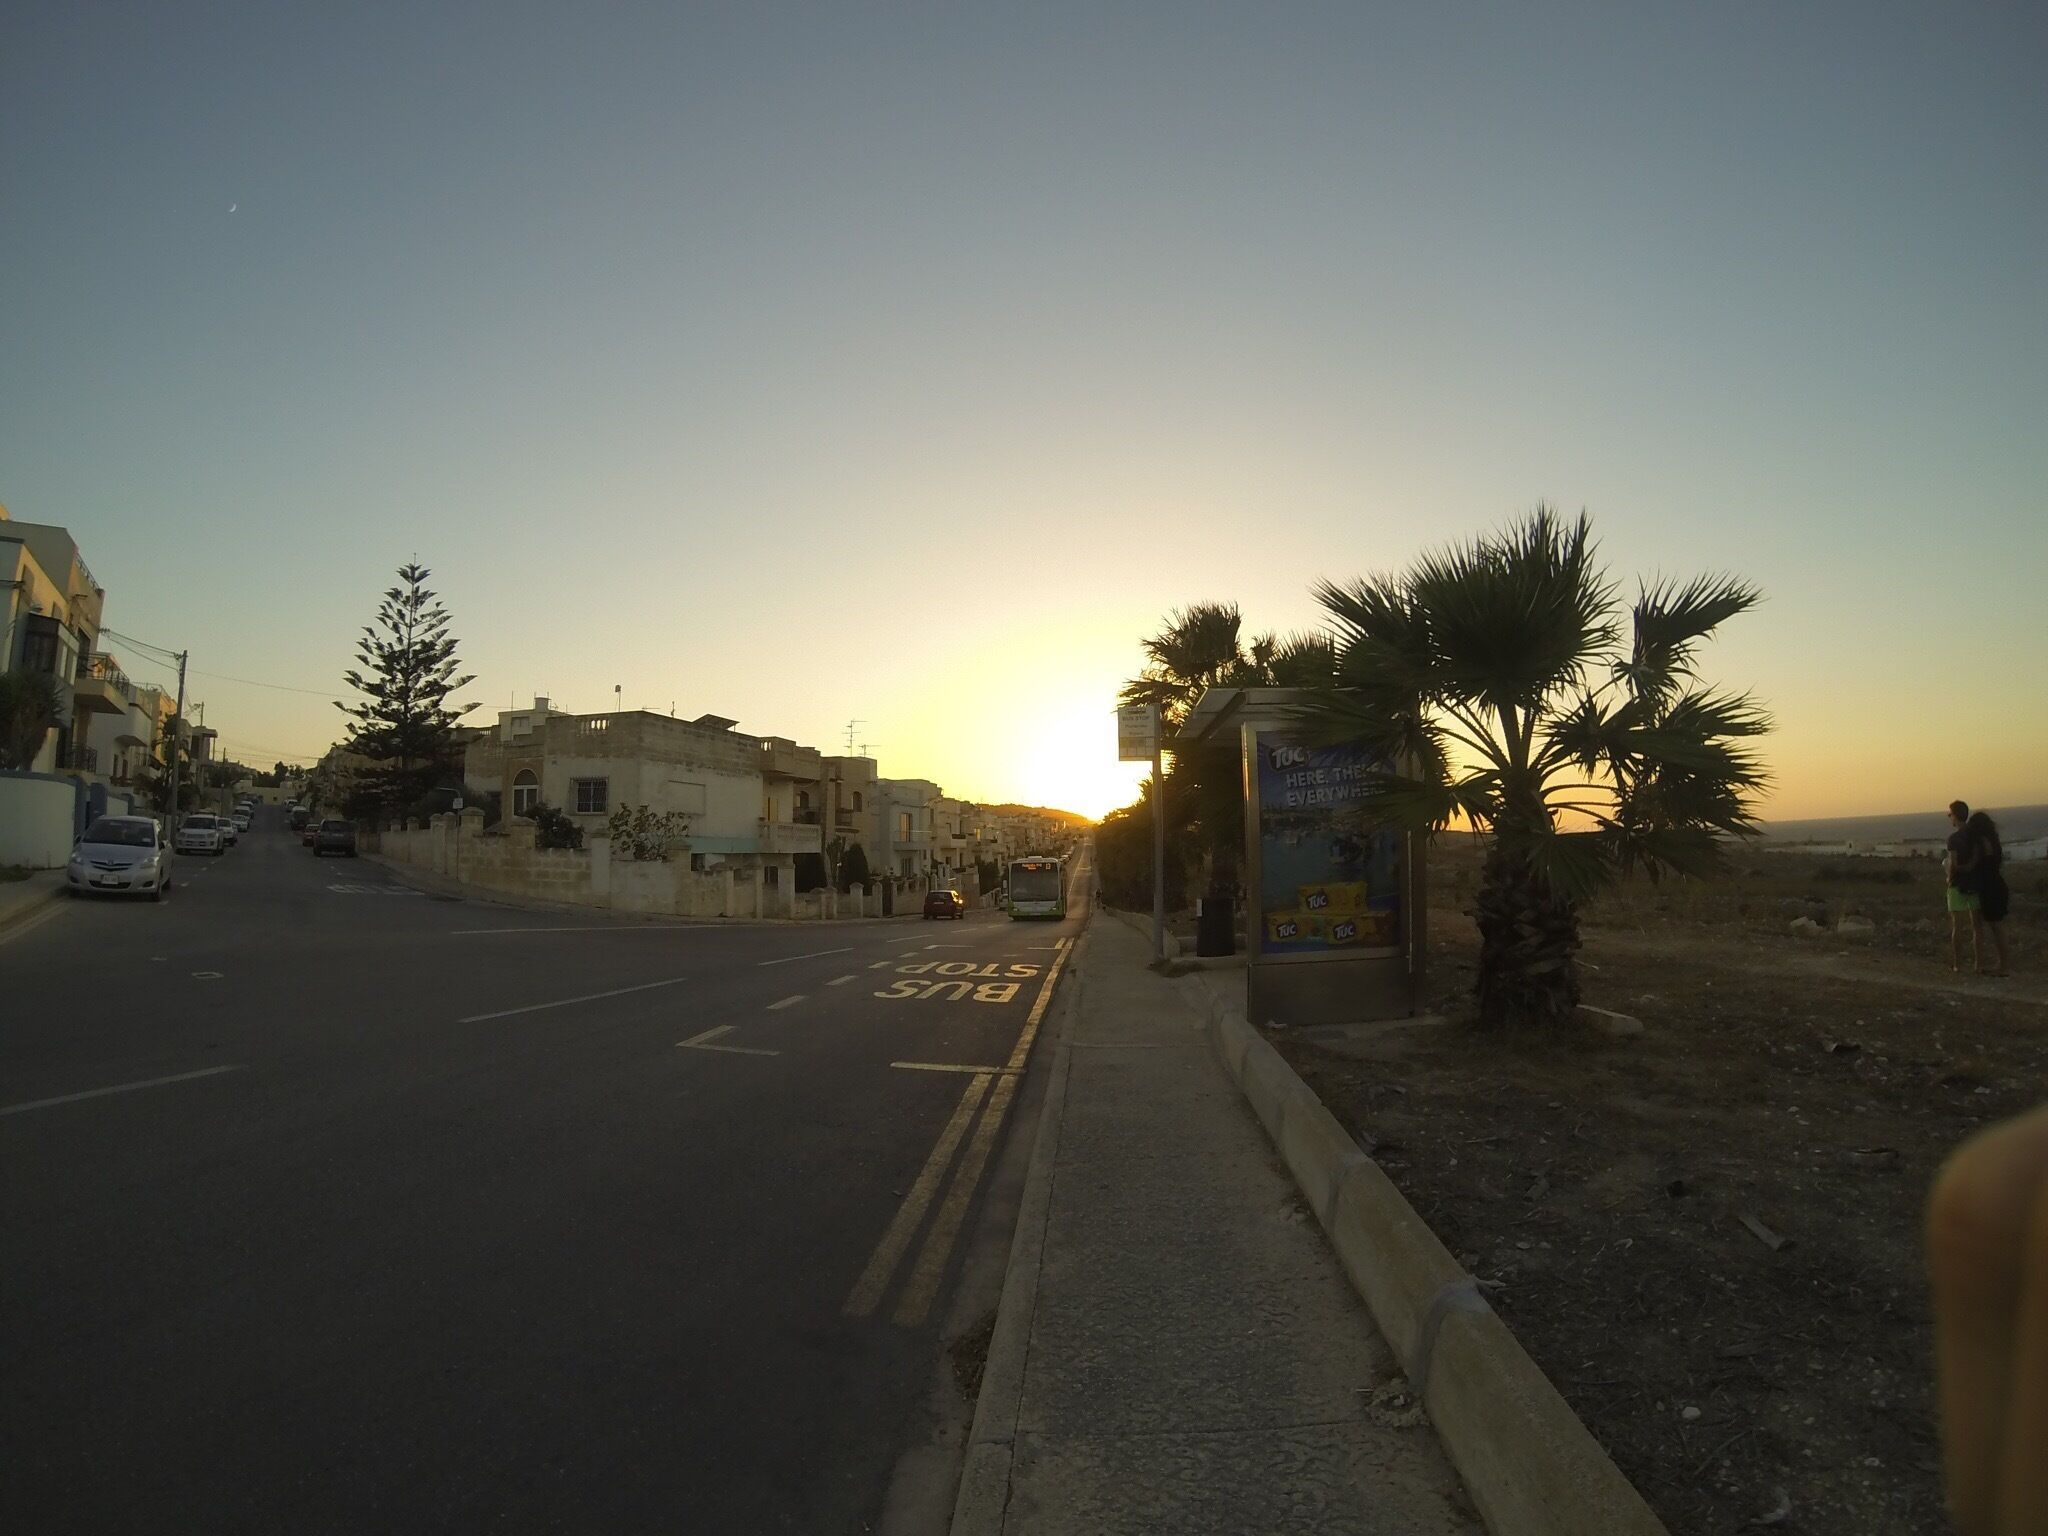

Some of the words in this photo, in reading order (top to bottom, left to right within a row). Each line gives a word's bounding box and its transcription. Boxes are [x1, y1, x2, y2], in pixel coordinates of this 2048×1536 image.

[1272, 746, 1305, 769] TUC
[1307, 895, 1327, 909] TUC
[1278, 924, 1297, 938] TUC
[1334, 924, 1355, 939] TUC
[895, 961, 1043, 978] STOP
[873, 979, 1022, 1003] BUS
